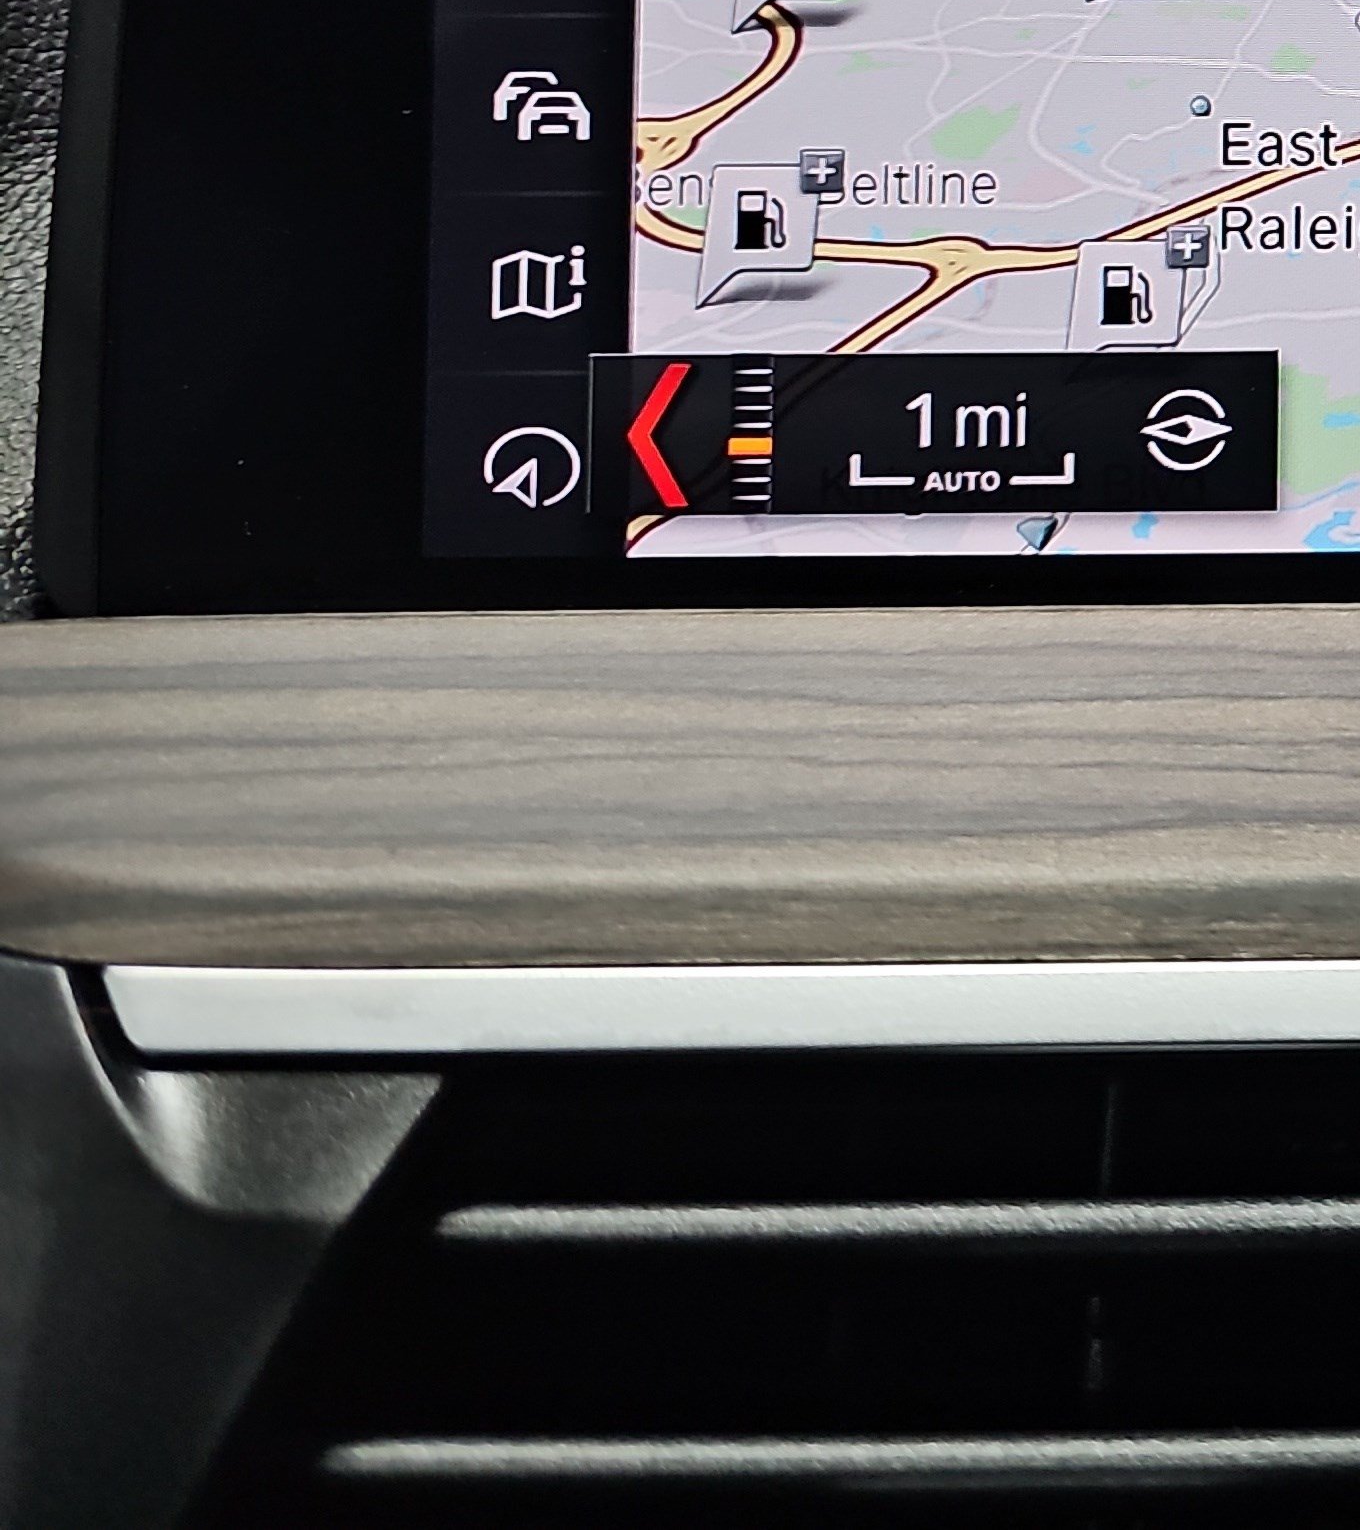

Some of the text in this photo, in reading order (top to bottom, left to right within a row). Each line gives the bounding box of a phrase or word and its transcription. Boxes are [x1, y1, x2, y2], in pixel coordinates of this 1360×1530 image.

[1223, 123, 1340, 167] East
[905, 392, 1027, 448] 1 mi
[923, 470, 1001, 492] AUTO
